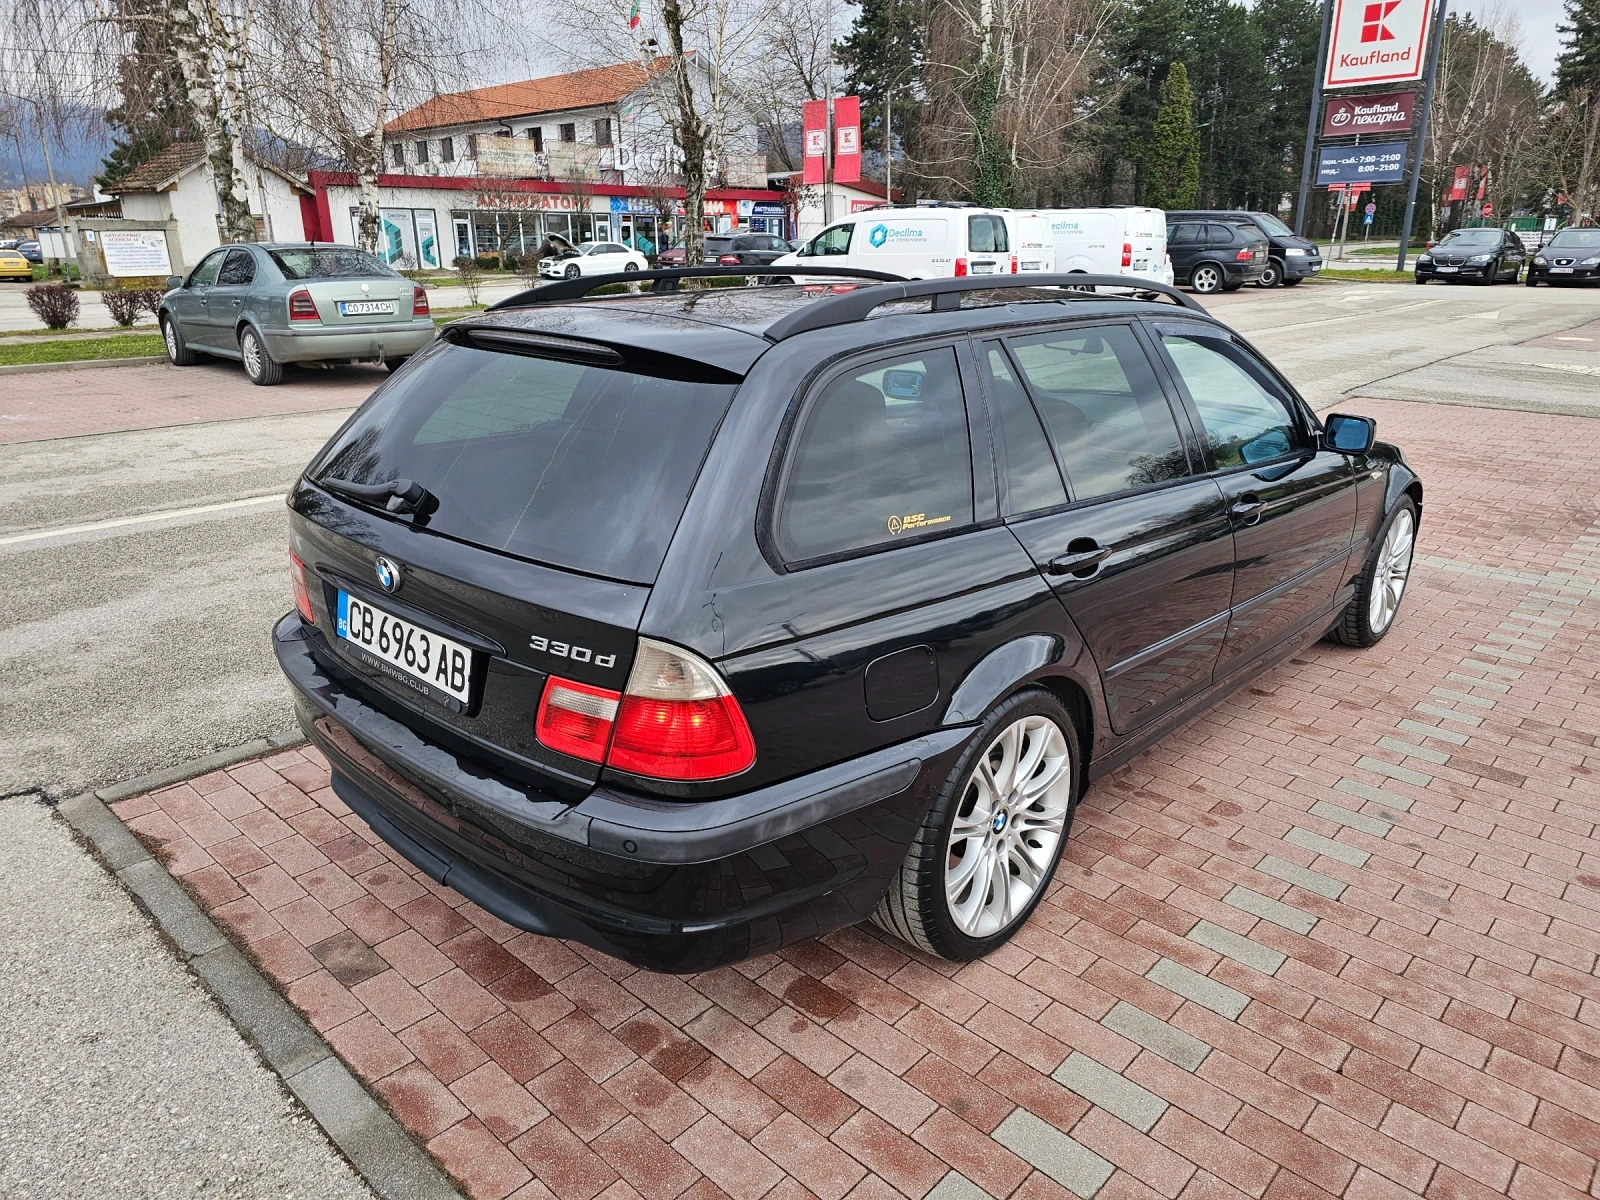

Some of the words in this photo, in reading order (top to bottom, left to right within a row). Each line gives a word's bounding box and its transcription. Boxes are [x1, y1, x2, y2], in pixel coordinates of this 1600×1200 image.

[1340, 47, 1411, 68] Kaufland
[1354, 102, 1399, 115] Kaufland
[1352, 111, 1406, 125] пекарна
[888, 228, 922, 237] Declima
[1051, 221, 1079, 230] eclima
[903, 515, 951, 530] Performance
[904, 513, 925, 524] DSC
[338, 617, 347, 631] BG
[529, 635, 617, 668] 330d
[361, 652, 429, 696] WWW.BMWBG.CLUB
